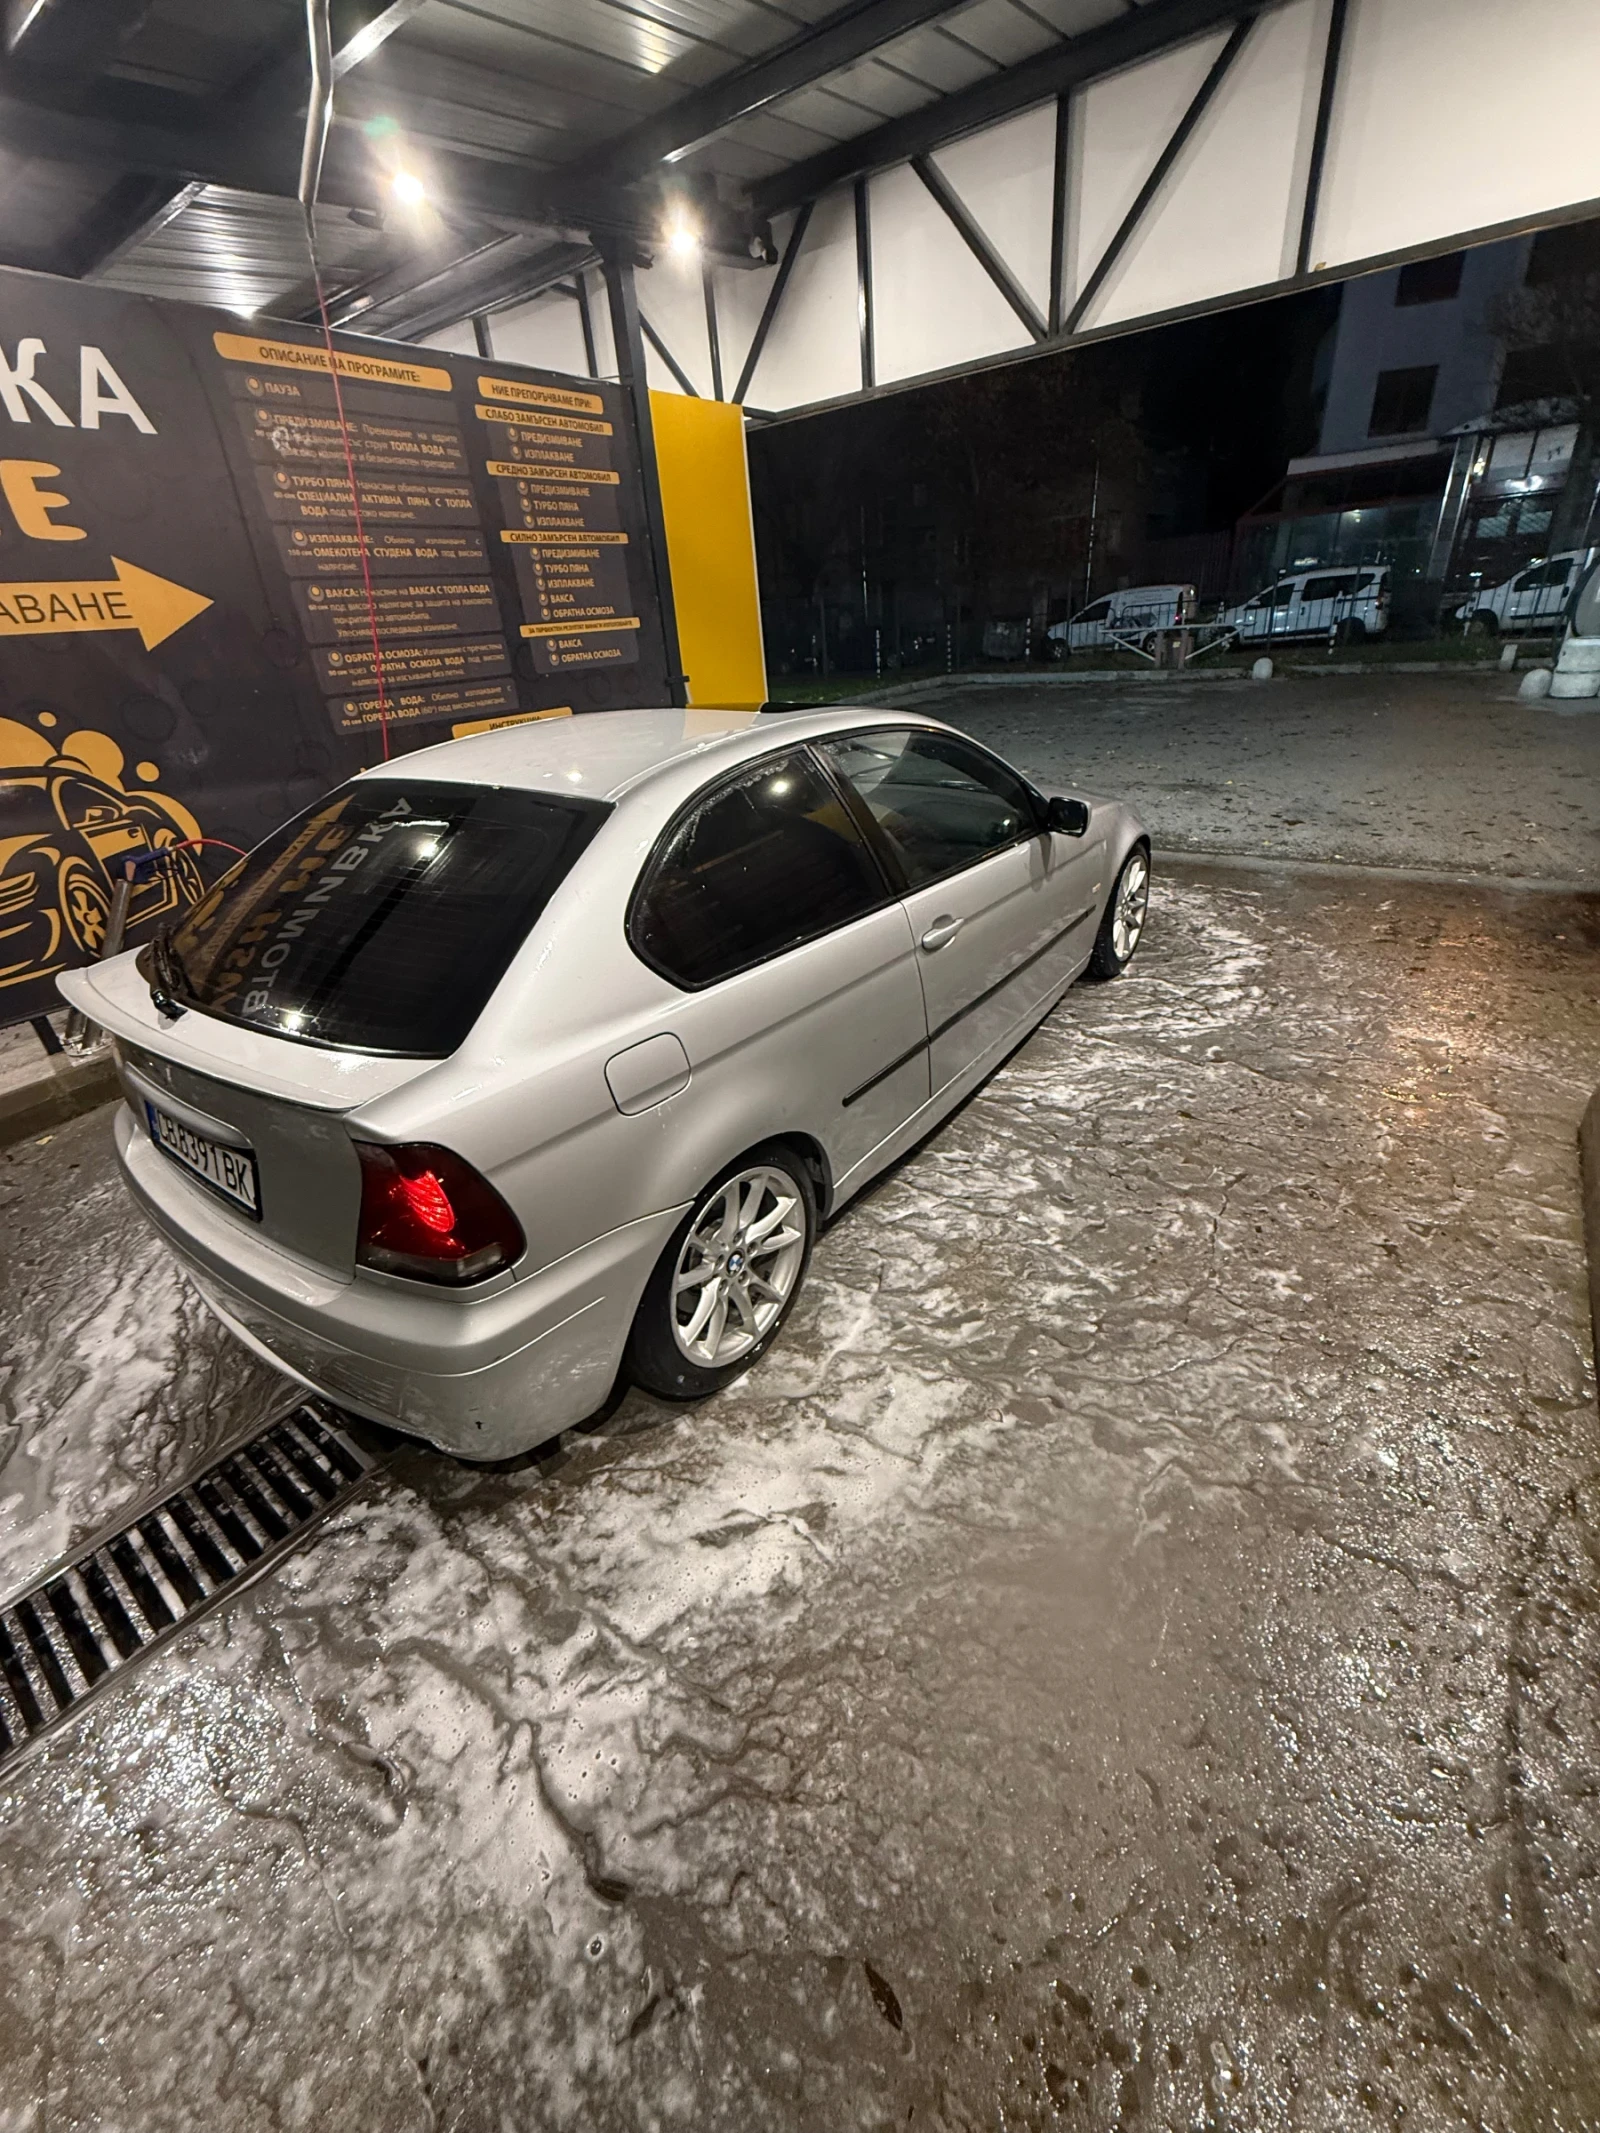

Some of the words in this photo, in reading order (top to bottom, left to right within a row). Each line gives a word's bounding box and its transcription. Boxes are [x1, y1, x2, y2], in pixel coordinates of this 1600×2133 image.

[260, 346, 327, 367] ОПИСАНИЕ
[347, 360, 421, 383] ПРОГРАМИТЕ:
[264, 382, 301, 396] ПАУЗА
[491, 384, 510, 396] НИЕ
[510, 387, 574, 406] ПРЕПОРЪЧВАМЕ
[574, 397, 592, 409] ПРИ:
[485, 408, 515, 421] СЛАБО
[516, 412, 557, 427] ЗАМЪРСЕН
[559, 418, 604, 433] АВТОМОБИЛ
[521, 431, 583, 447] ПРЕДИЗМИВАНЕ
[390, 441, 420, 453] ТОПЛА
[420, 444, 445, 456] ВОДА
[524, 448, 574, 462] ИЗПЛАКВАНЕ
[496, 464, 529, 476] СРЕДНО
[528, 466, 568, 479] ЗАМЪРСЕН
[569, 470, 611, 482] АВТОМОБИЛ
[291, 476, 325, 487] ТУРБО
[530, 483, 590, 497] ПРЕДИЗМИВАНЕ
[296, 491, 355, 503] СПЕЦИАЛНА
[361, 494, 403, 505] АКТИВНА
[407, 496, 431, 506] ПЯНА
[435, 498, 442, 507] С
[445, 498, 472, 509] ТОПЛА
[533, 500, 558, 511] ТУРБО
[558, 501, 579, 511] ПЯНА
[300, 505, 329, 518] ВОДА
[536, 516, 585, 527] ИЗПЛАКВАНЕ
[510, 532, 538, 542] СИЛНО
[539, 533, 577, 542] ЗАМЪРСЕН
[578, 534, 620, 542] АВТОМОБИЛ
[313, 547, 371, 557] ОМЕКОТЕНА
[373, 547, 413, 558] СТУДЕНА
[415, 548, 439, 558] ВОДА
[541, 548, 600, 559] ПРЕДИЗМИВАНЕ
[544, 564, 568, 574] ТУРБО
[569, 563, 590, 573] ПЯНА
[547, 578, 595, 588] ИЗПЛАКВАНЕ
[325, 588, 359, 598] ВАКСА:
[408, 586, 436, 596] ВАКСА
[436, 586, 443, 595] С
[442, 585, 469, 594] ТОПЛА
[468, 584, 490, 594] ВОДА
[550, 594, 575, 604] ВАКСА
[552, 607, 586, 618] ОБРАТНА
[586, 606, 615, 616] ОСМОЗА
[558, 639, 583, 648] ВАКСА
[344, 651, 385, 663] ОБРАТНА
[385, 648, 423, 659] ОСМОЗА:
[561, 651, 593, 663] ОБРАТНА
[594, 649, 622, 660] ОСМОЗА
[409, 658, 442, 669] ОСМОЗА
[444, 656, 465, 666] ВОДА
[400, 695, 426, 706] ВОДА:
[398, 708, 421, 719] ВОДА
